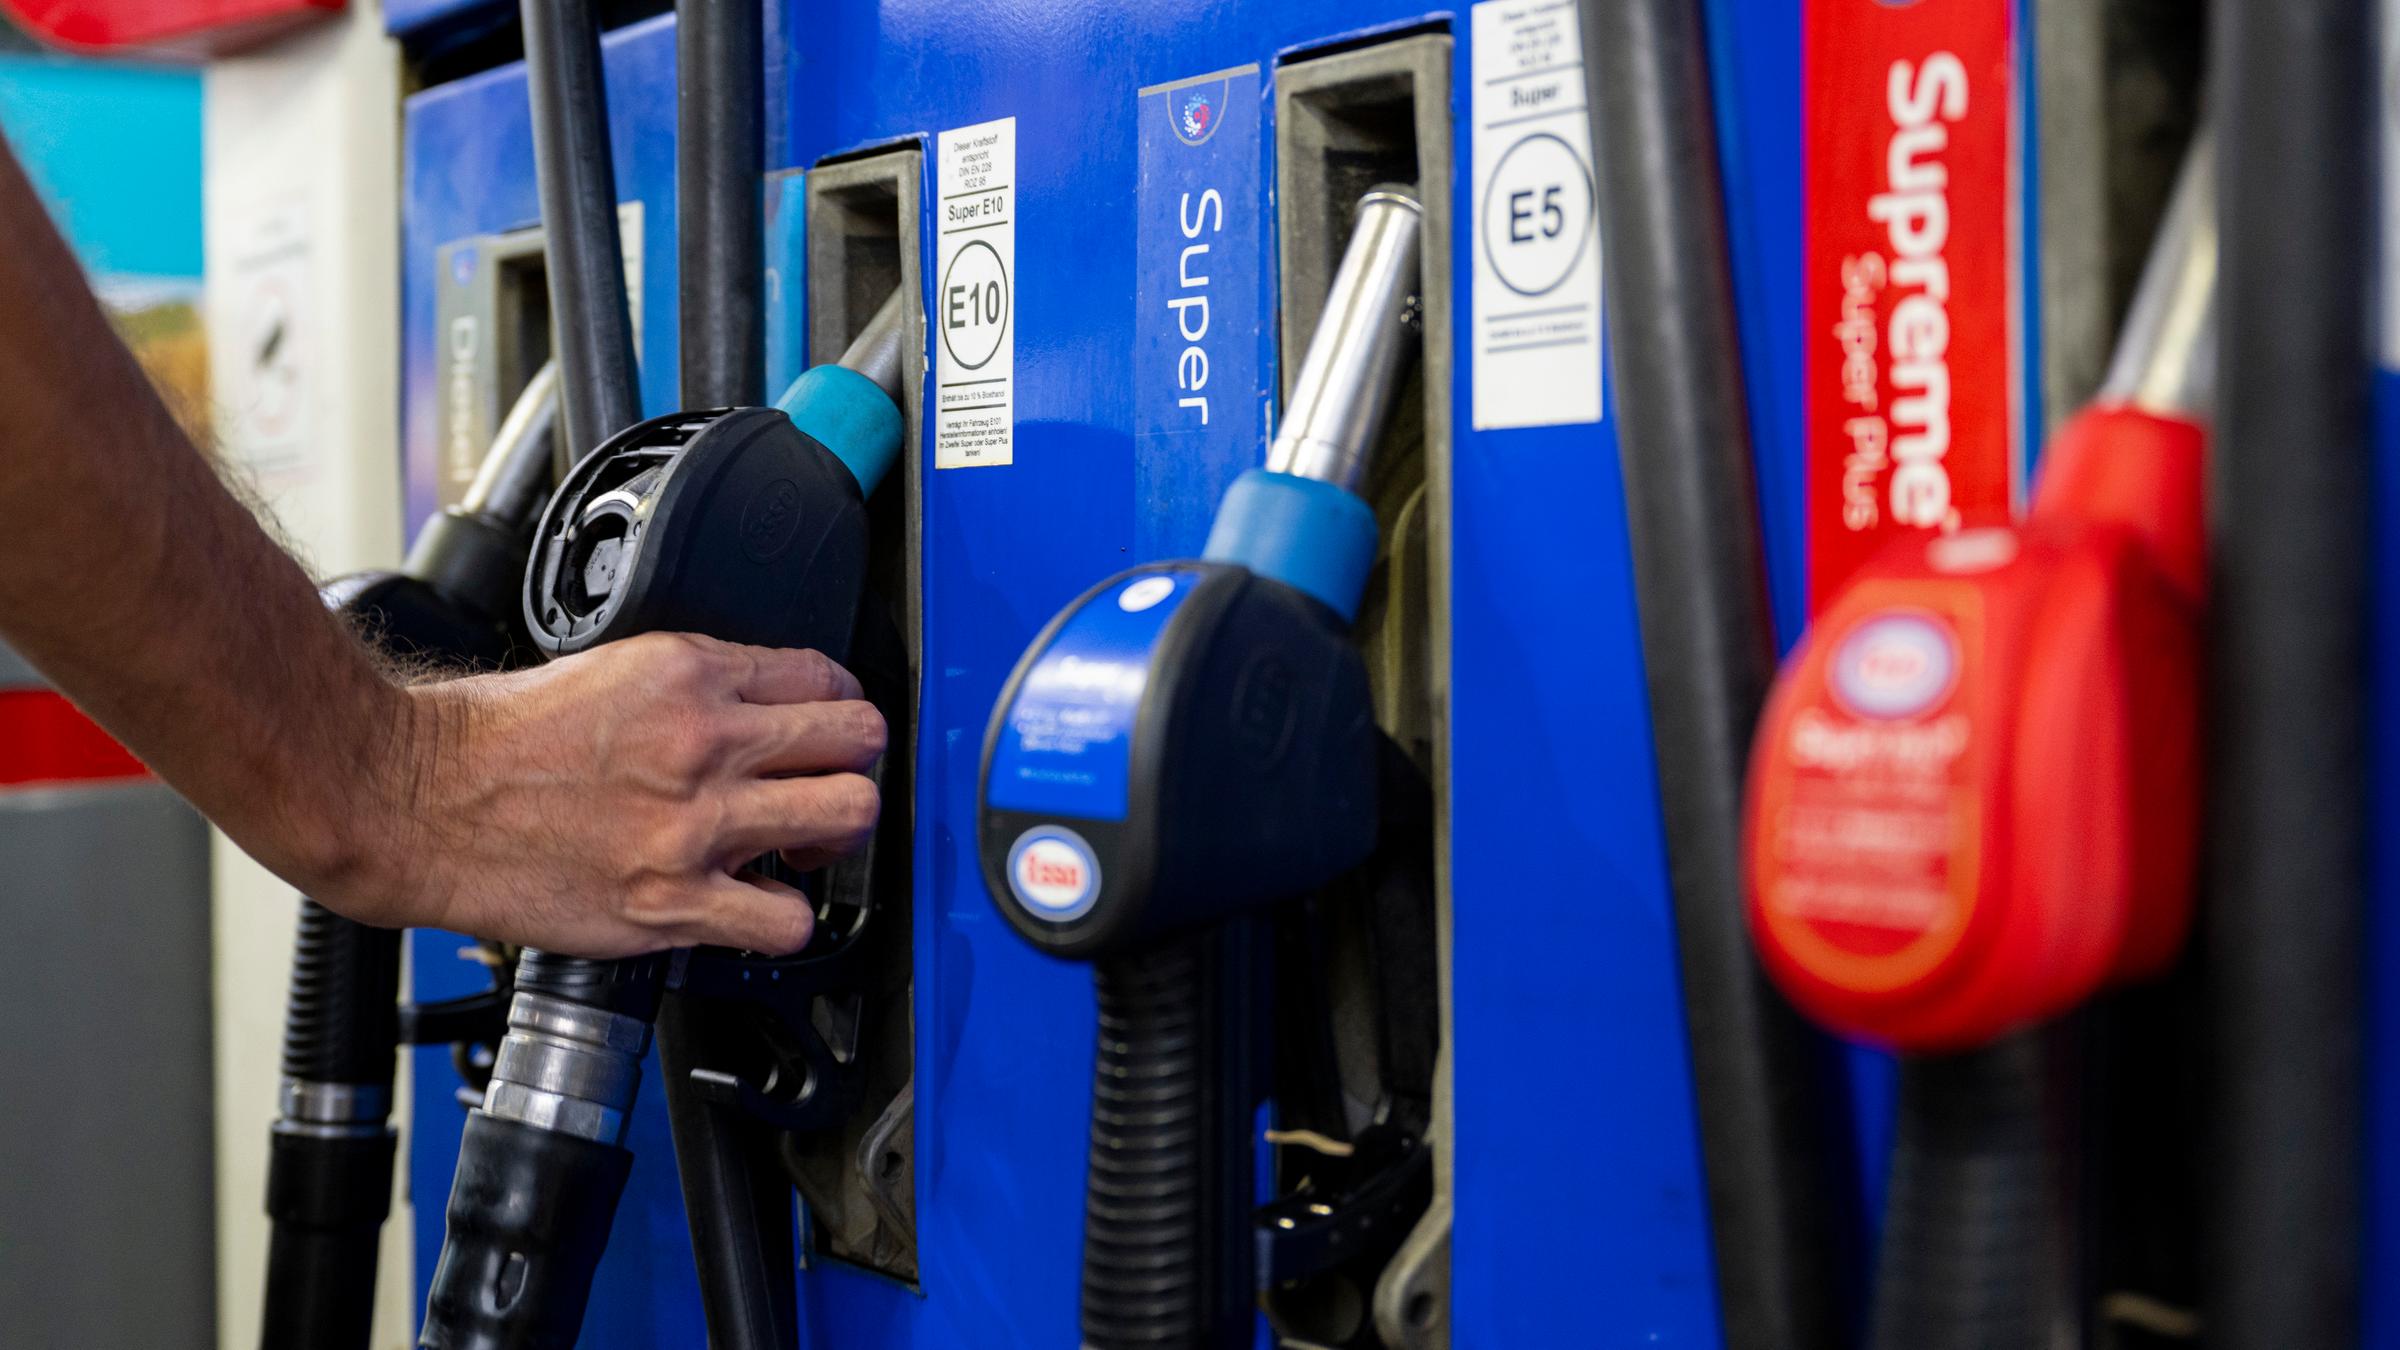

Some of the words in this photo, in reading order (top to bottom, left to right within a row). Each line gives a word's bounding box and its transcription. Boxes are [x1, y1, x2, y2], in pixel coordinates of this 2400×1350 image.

[948, 204, 980, 223] Super
[983, 196, 1003, 215] E10
[1510, 186, 1565, 244] E5
[949, 280, 1000, 329] E10
[1167, 188, 1223, 425] Super
[1832, 251, 1888, 412] Super
[1867, 50, 1969, 528] Supreme
[1842, 415, 1889, 532] Plus
